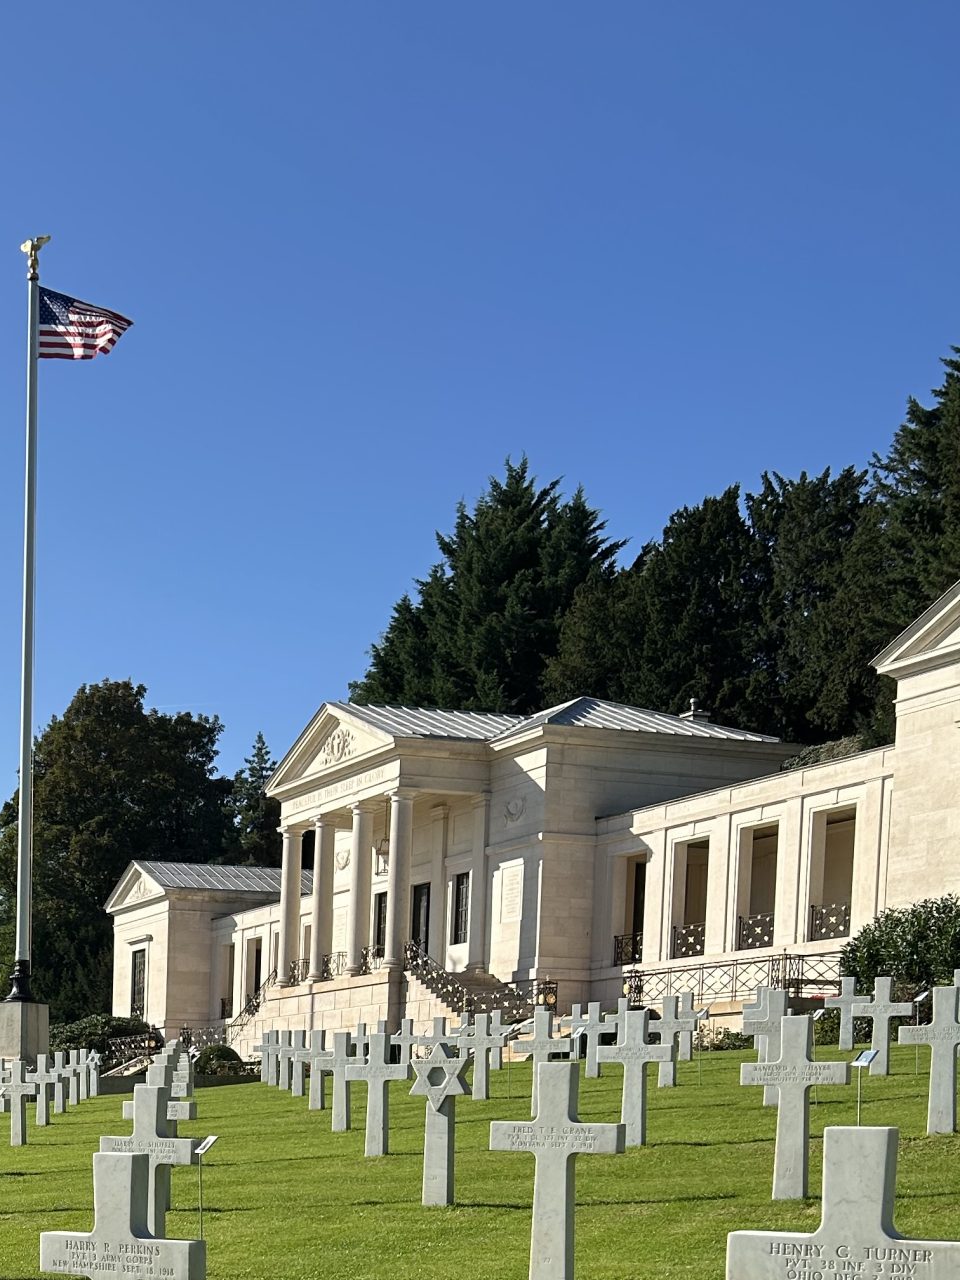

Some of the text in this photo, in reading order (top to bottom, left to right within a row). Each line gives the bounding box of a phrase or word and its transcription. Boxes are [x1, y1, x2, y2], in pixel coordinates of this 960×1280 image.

[65, 1240, 97, 1251] HARRY
[119, 1244, 160, 1256] PERKINS
[769, 1242, 824, 1258] HENRY
[864, 1247, 933, 1263] TURNER
[52, 1260, 69, 1268] NEW
[821, 1261, 835, 1270] 38
[876, 1263, 884, 1274] 3
